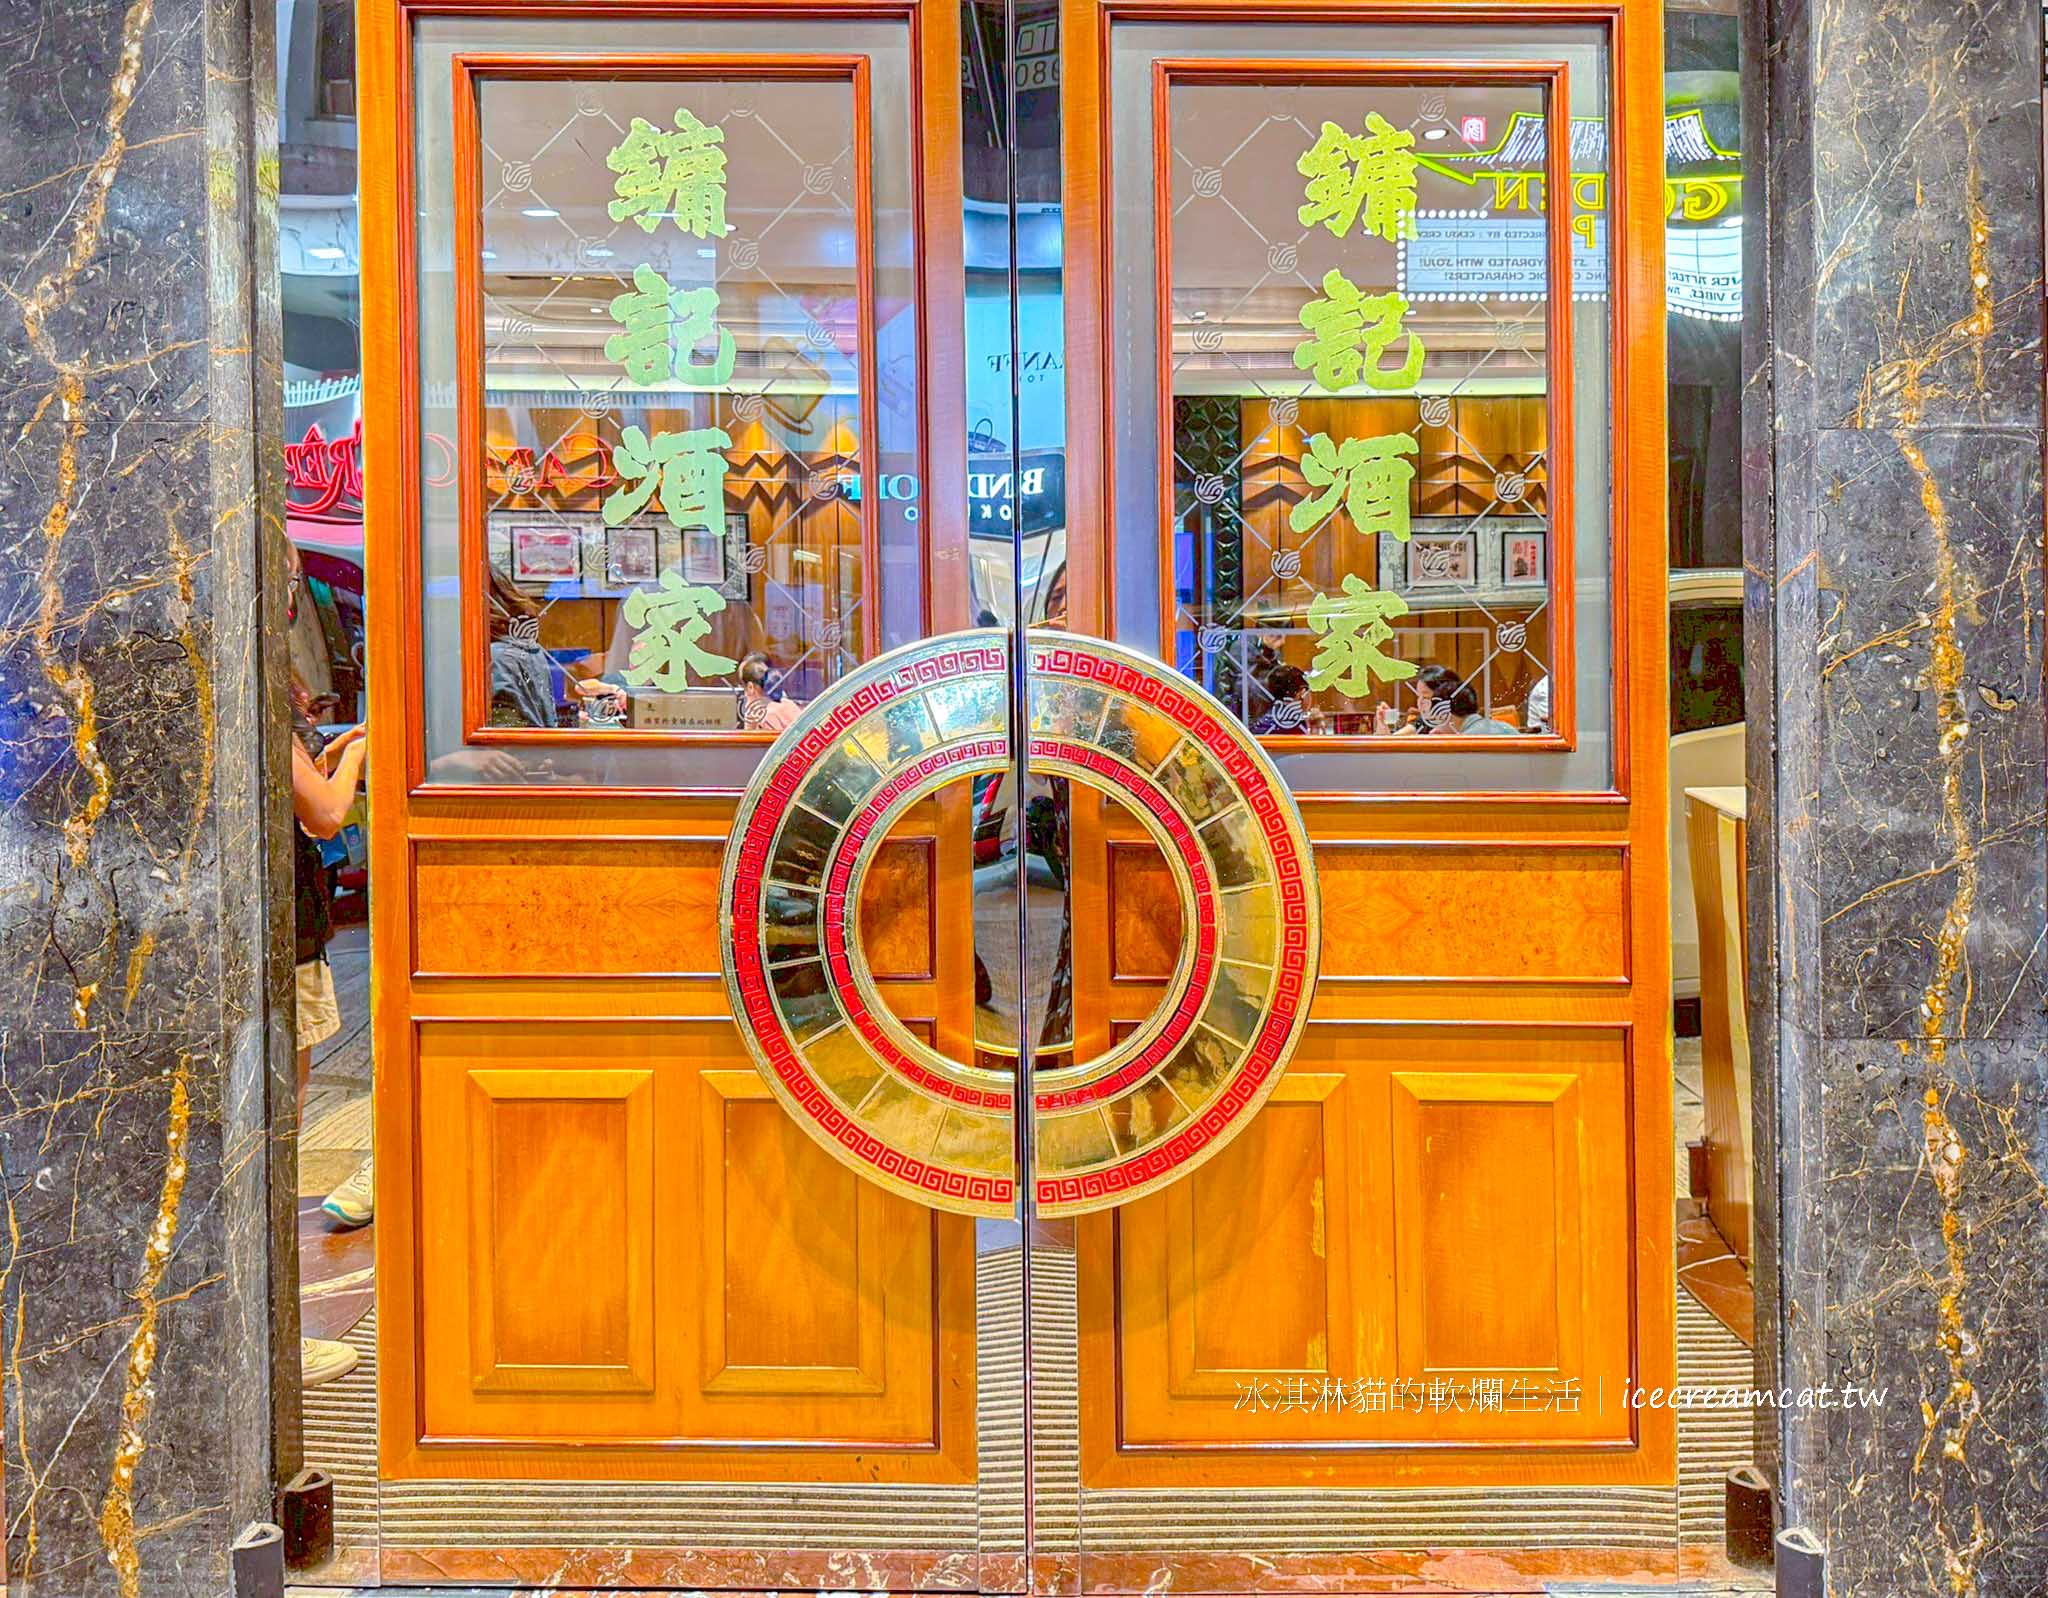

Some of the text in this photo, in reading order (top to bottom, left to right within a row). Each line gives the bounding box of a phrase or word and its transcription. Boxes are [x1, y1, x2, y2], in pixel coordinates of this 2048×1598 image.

[603, 108, 737, 692] 鏞記酒家
[1290, 111, 1425, 699] 鏞記酒家
